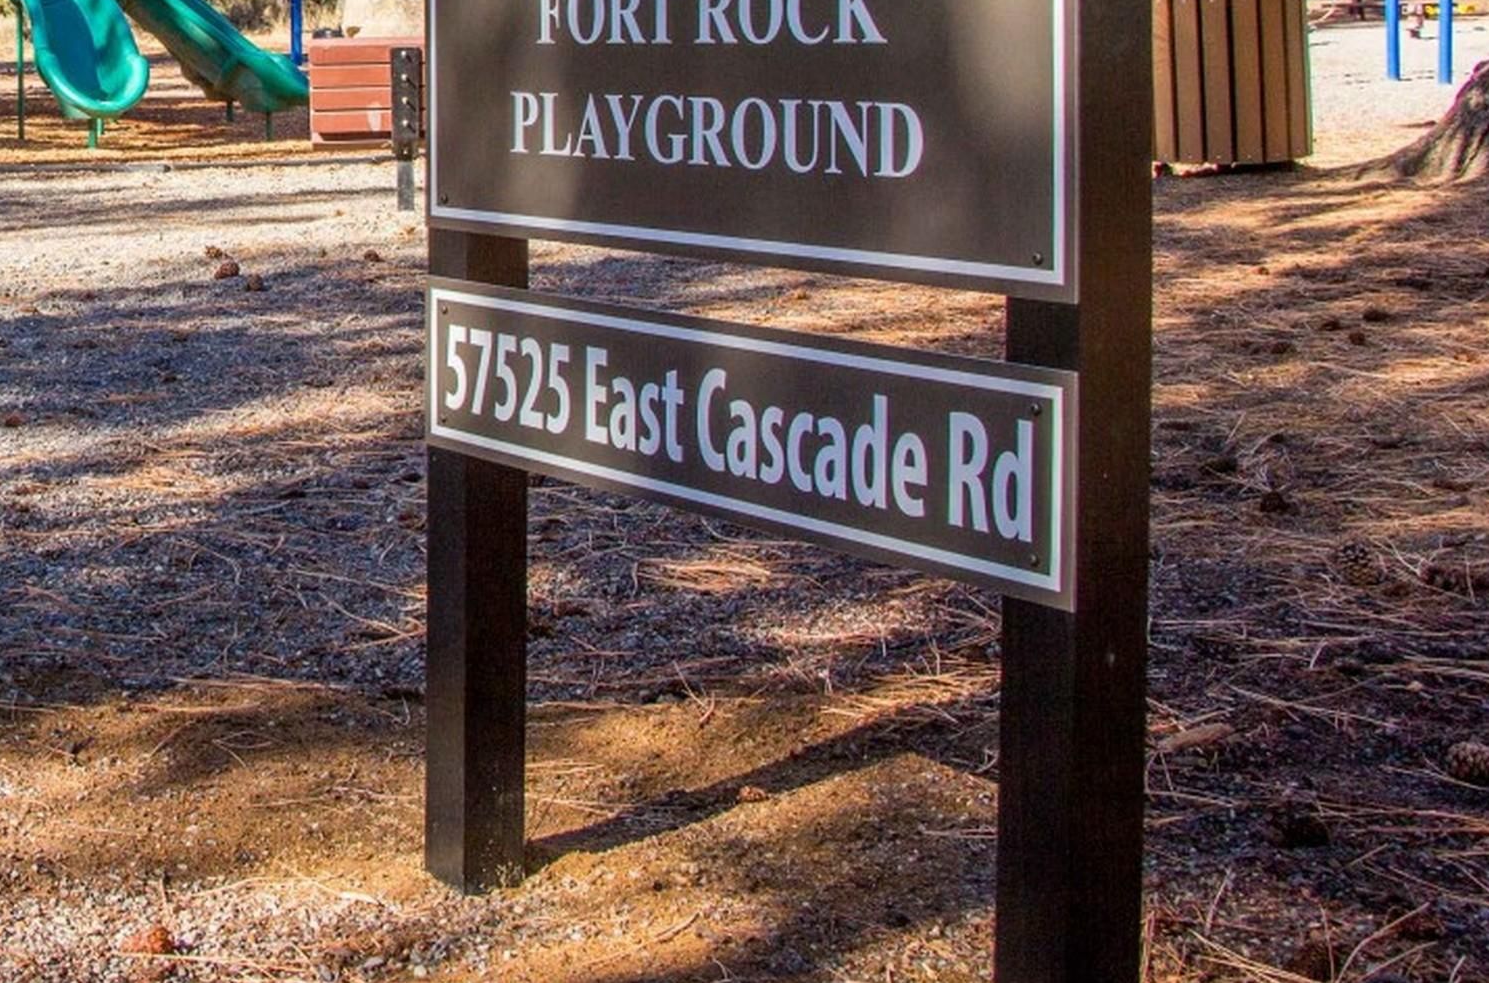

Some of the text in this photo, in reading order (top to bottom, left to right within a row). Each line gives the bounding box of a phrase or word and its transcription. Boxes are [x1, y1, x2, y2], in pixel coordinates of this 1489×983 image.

[510, 91, 923, 178] PLAYGROUND
[445, 324, 1033, 543] 57525 East Cascade Rd
